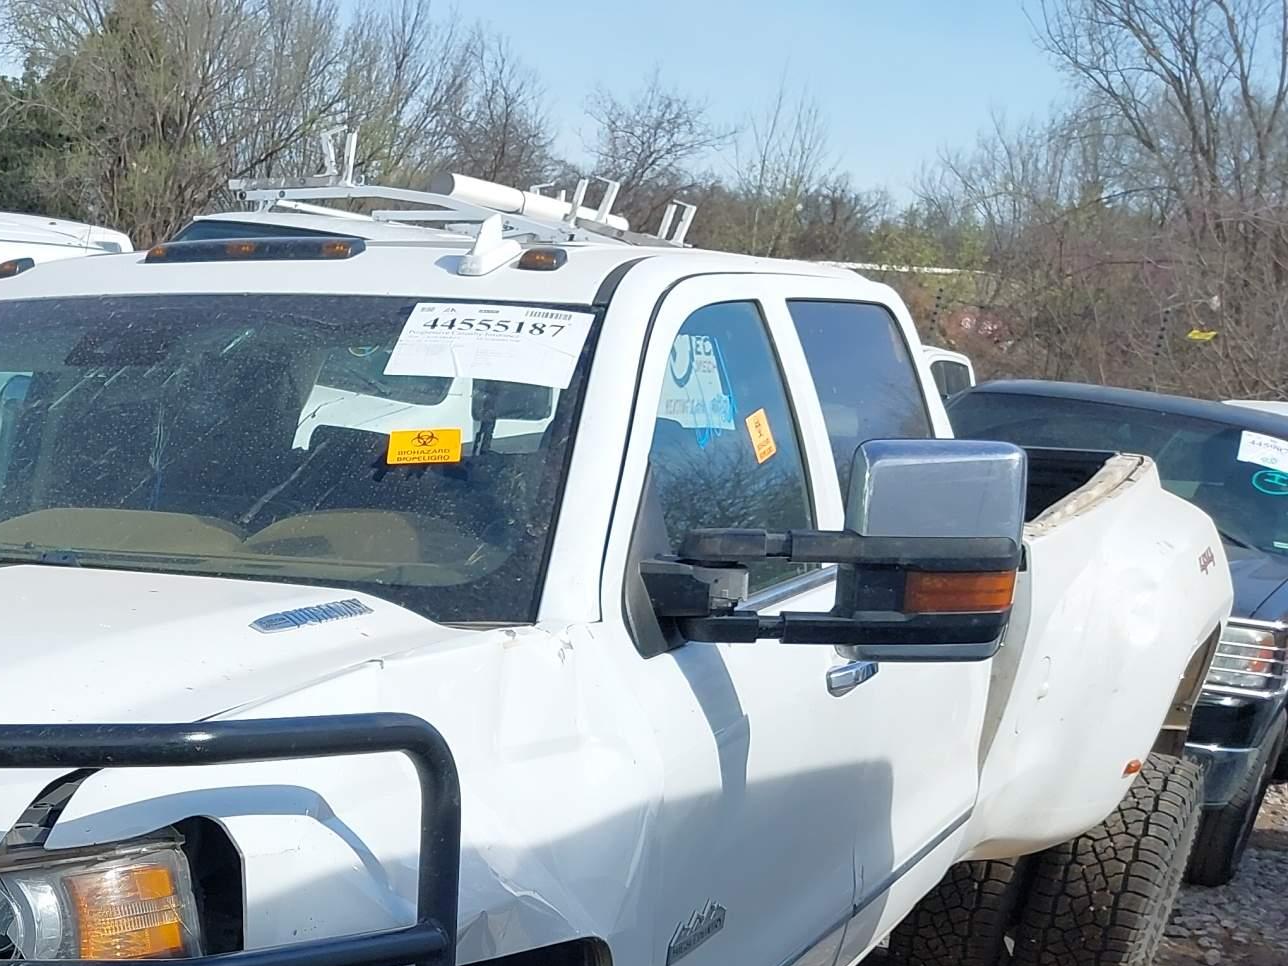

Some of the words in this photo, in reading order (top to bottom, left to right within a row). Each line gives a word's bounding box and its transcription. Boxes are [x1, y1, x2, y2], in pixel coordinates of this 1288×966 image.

[423, 317, 565, 338] 44555187
[397, 448, 450, 456] BIOHAZARD
[396, 454, 450, 462] BIOPELIGRO
